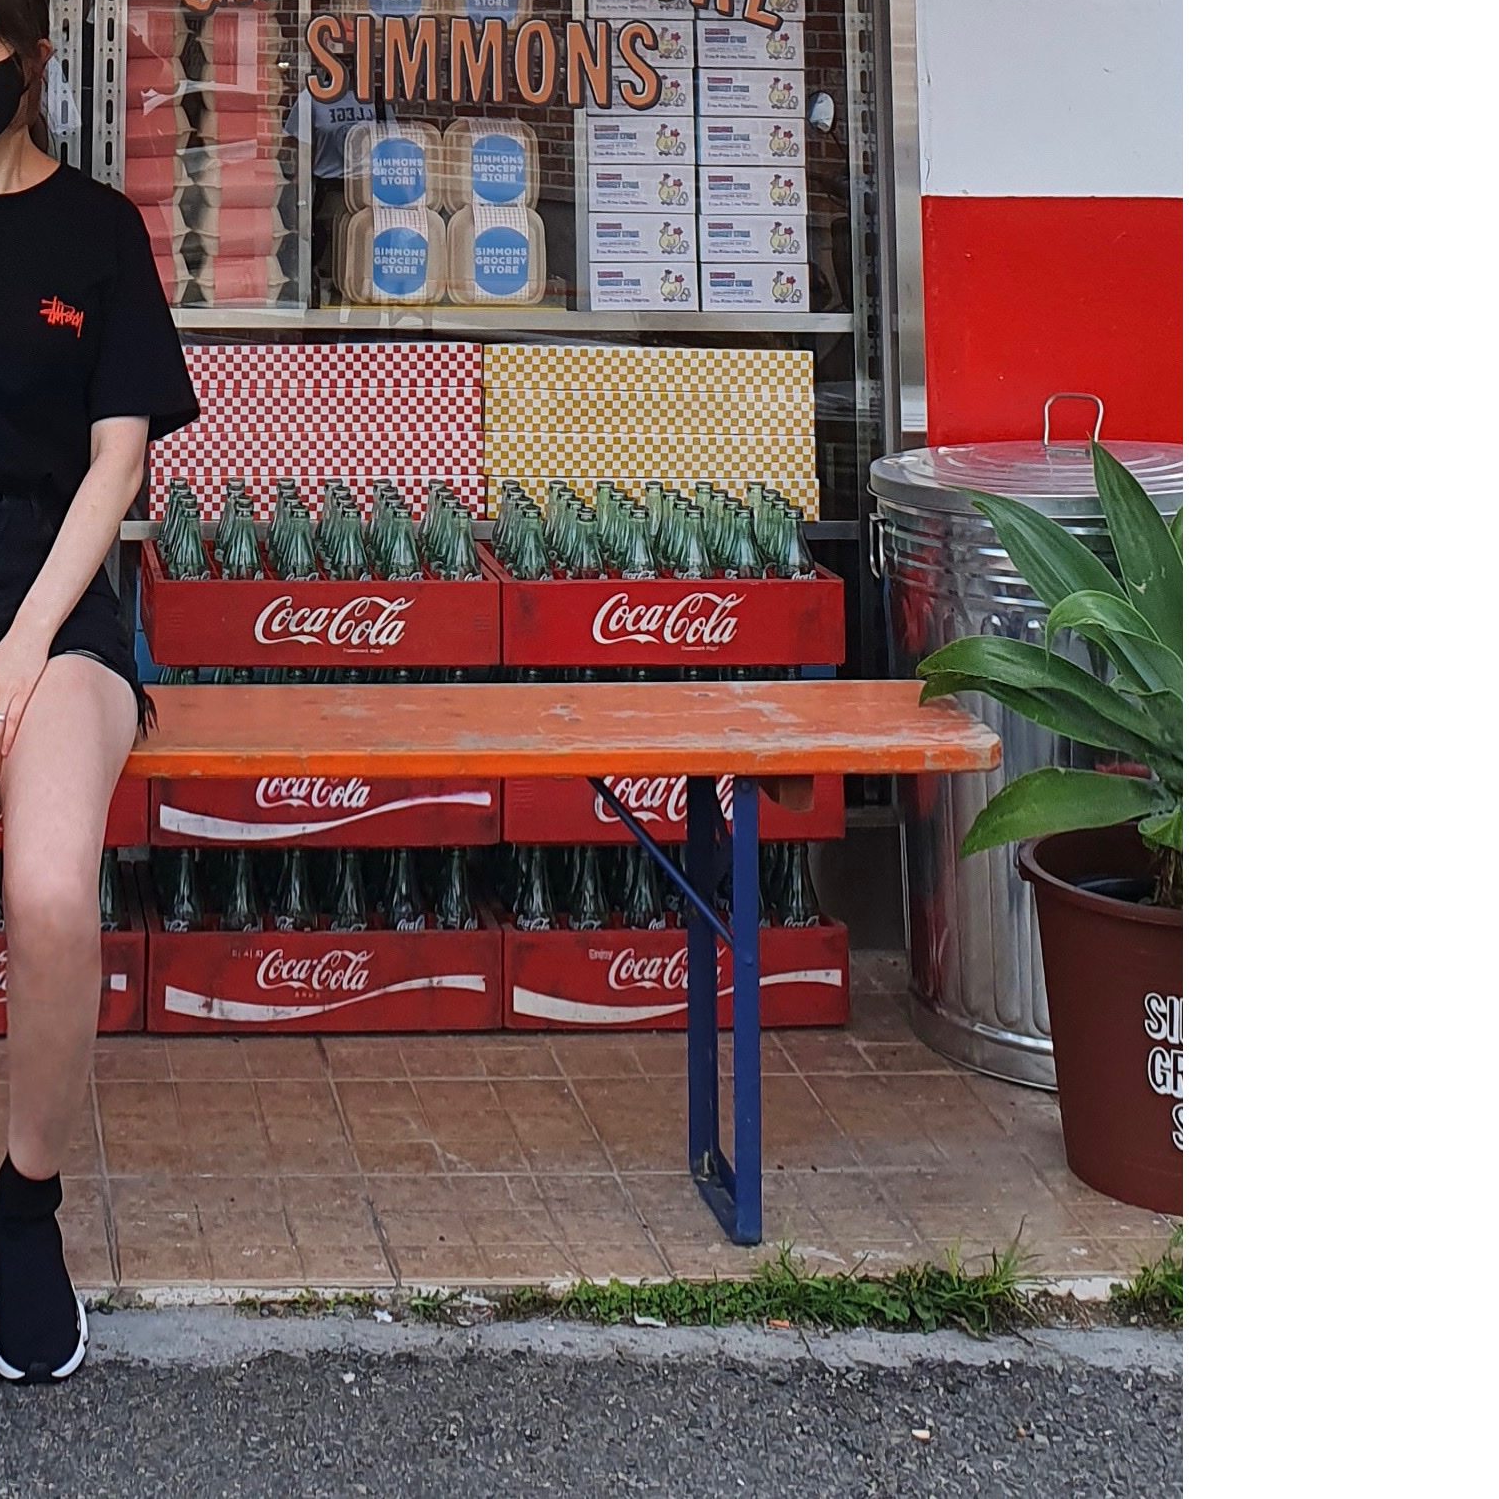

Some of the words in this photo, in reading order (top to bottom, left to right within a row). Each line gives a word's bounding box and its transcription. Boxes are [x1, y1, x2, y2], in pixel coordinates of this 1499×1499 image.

[305, 15, 662, 110] SIMMONS
[372, 158, 424, 167] SIMMONS
[472, 154, 524, 164] SIMMONS
[372, 166, 424, 176] GROCERY
[472, 164, 524, 173] GROCERY
[380, 176, 416, 186] STORE
[480, 173, 517, 182] STORE
[374, 247, 426, 257] SIMMONS
[475, 247, 527, 256] SIMMONS
[373, 256, 426, 266] GROCERY
[474, 256, 527, 266] GROCERY
[381, 265, 418, 275] STORE
[482, 265, 519, 275] STORE
[254, 595, 416, 646] Coca-Cola
[592, 592, 746, 645] Coca-Cola
[256, 948, 375, 991] Coca-Cola
